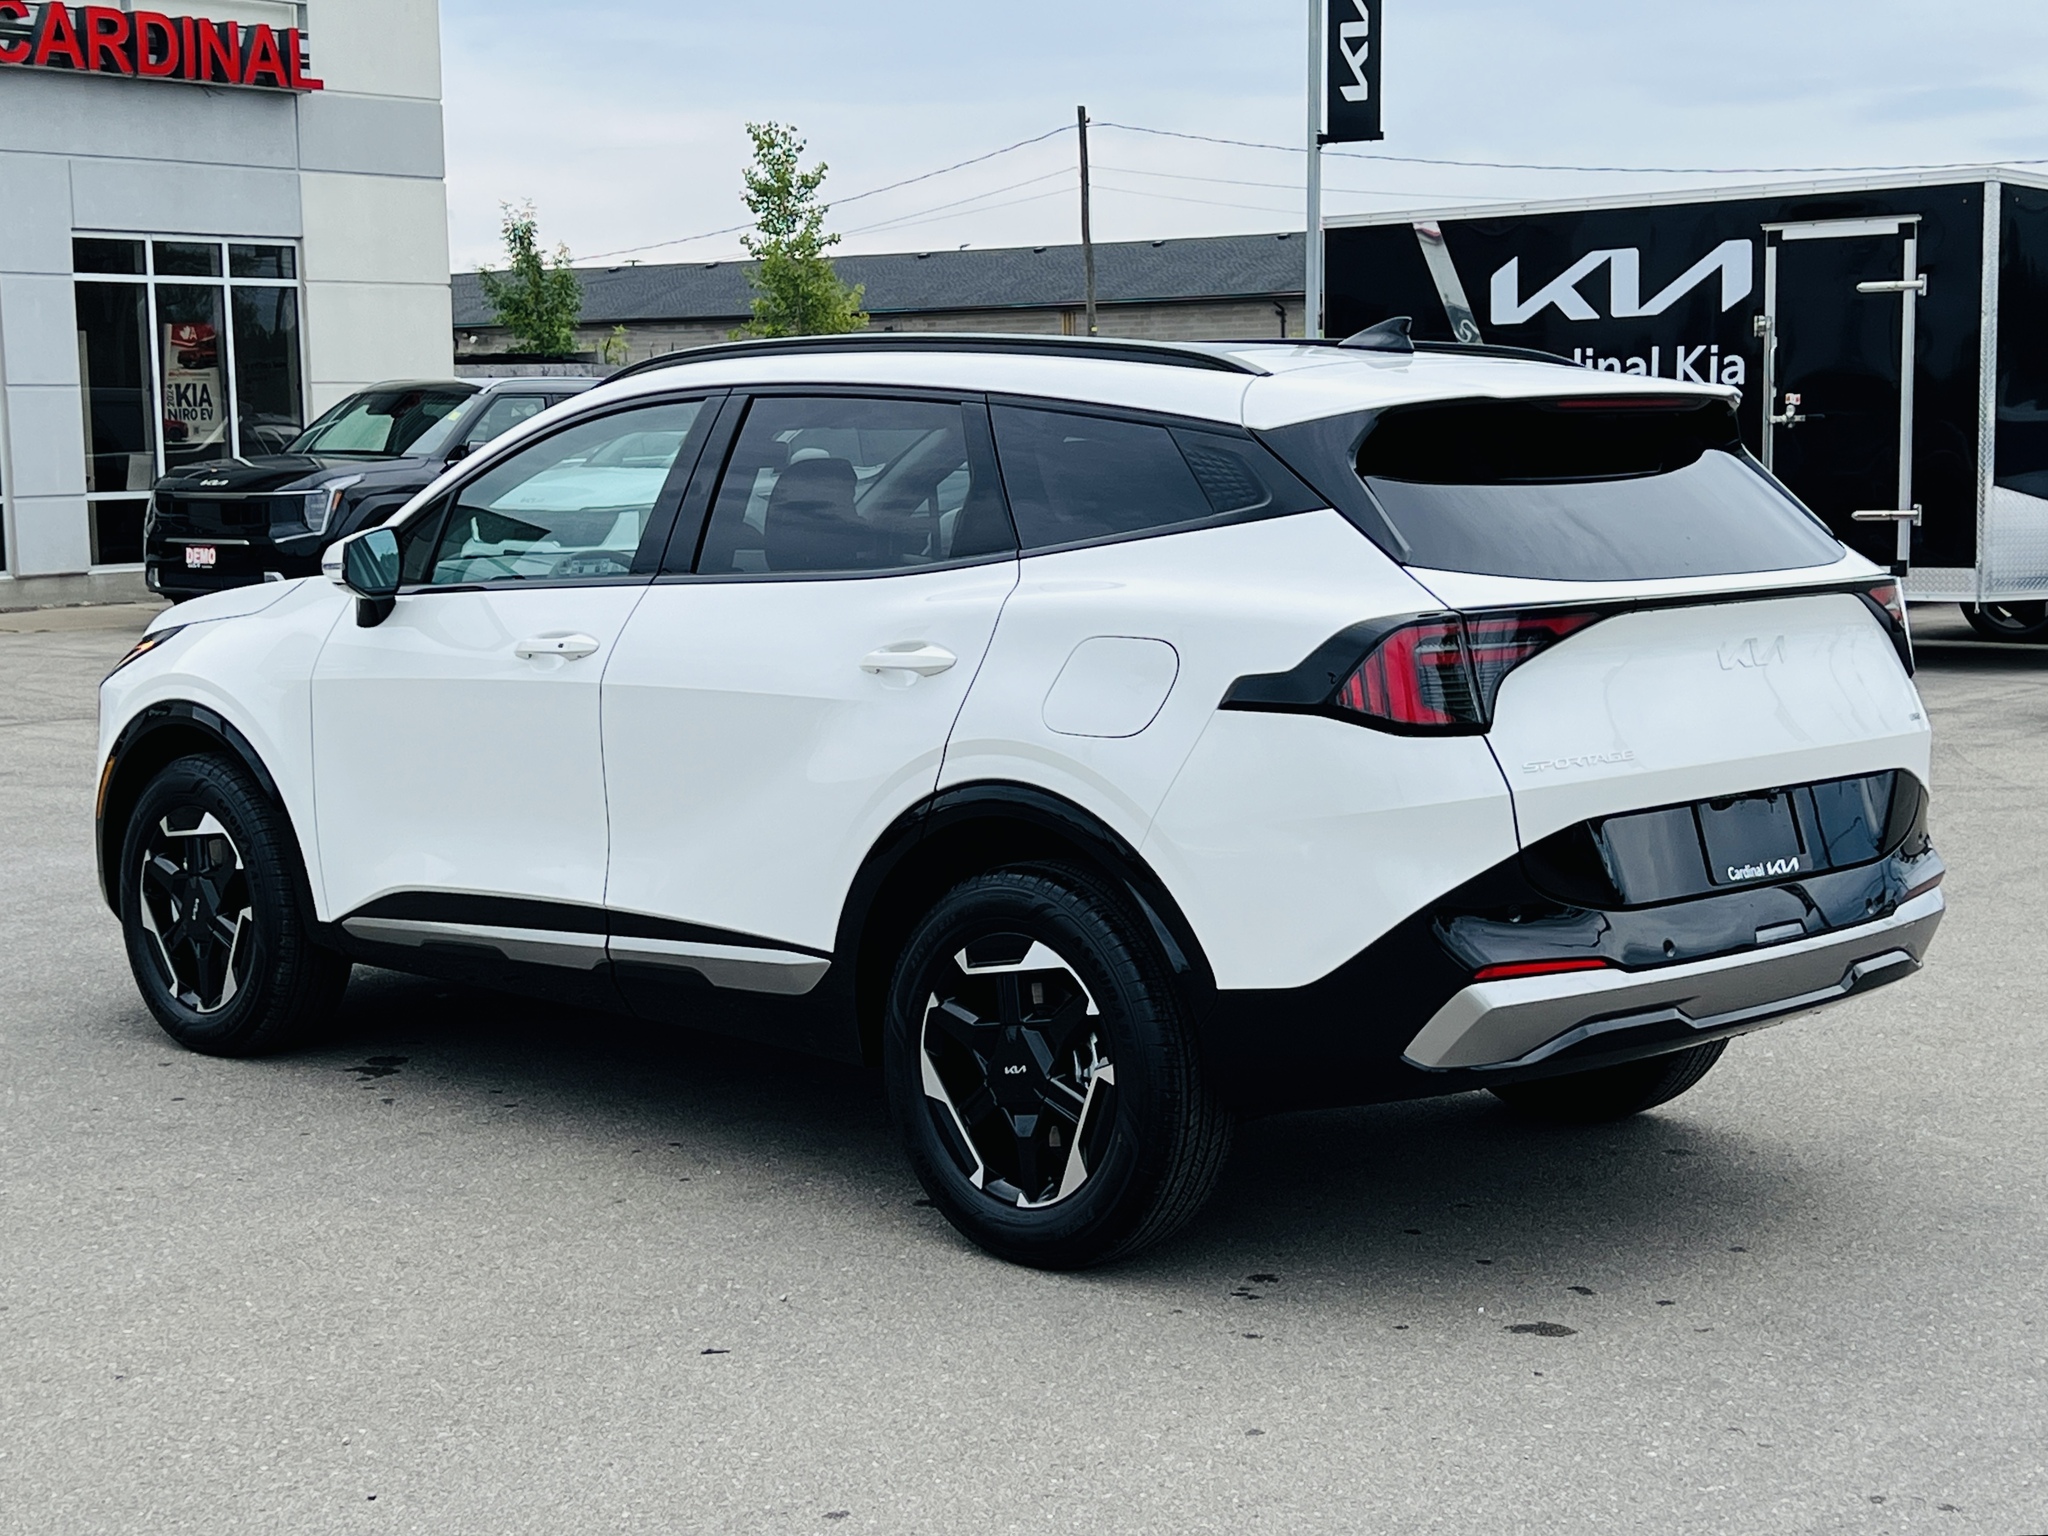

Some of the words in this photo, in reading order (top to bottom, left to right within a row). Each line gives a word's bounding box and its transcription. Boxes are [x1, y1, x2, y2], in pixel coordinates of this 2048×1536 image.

[0, 0, 324, 90] CARDINAL
[1490, 239, 1753, 326] KIA
[1677, 344, 1746, 385] Kia
[174, 383, 213, 407] KIA
[167, 408, 198, 421] NIRO
[200, 408, 214, 421] EV
[186, 547, 216, 565] DEMO
[1715, 634, 1786, 671] KIA
[1522, 750, 1635, 774] SPORTAGE
[1727, 862, 1765, 881] Cardinal
[1766, 857, 1800, 876] KIA
[1004, 1065, 1027, 1075] KIA
